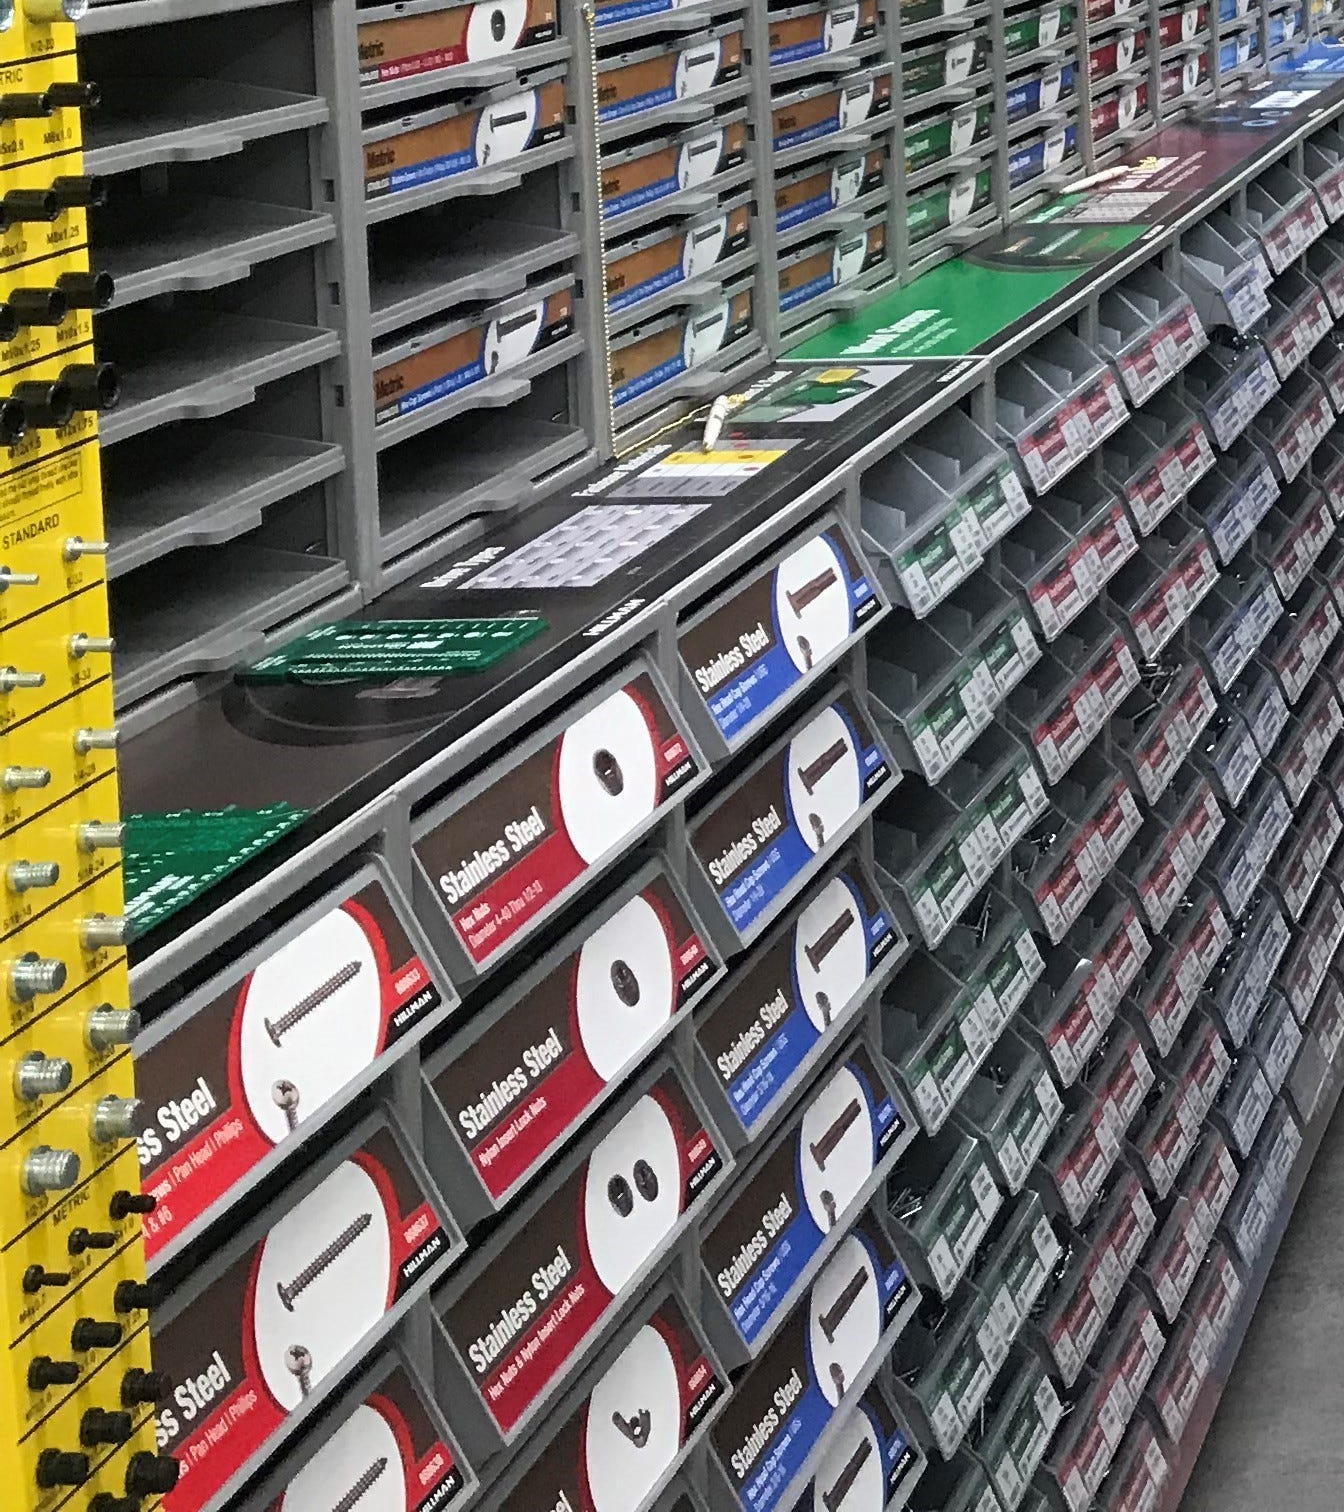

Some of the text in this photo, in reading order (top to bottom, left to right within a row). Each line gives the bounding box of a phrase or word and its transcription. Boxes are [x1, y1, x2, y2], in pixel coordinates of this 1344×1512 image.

[366, 147, 395, 171] Metric
[840, 309, 940, 354] Wood Screws
[375, 374, 403, 400] Metric
[3, 514, 59, 550] STANDARD
[420, 567, 472, 587] Drive
[583, 598, 646, 637] HILLMAN
[695, 622, 769, 692] Stainless Steel
[440, 806, 546, 904] Stainless Steel
[709, 804, 782, 885] Stainless Steel
[460, 913, 476, 932] Hex
[393, 991, 432, 1026] HILLMAN
[716, 988, 788, 1080] Stainless Steel
[459, 1027, 563, 1139] Stainless Steel
[157, 1077, 217, 1142] Steel
[478, 1097, 547, 1167] Nylon Insert Lock Nuts
[172, 1161, 192, 1182] Pan
[188, 1141, 213, 1168] Head
[213, 1119, 243, 1147] Phillips
[689, 1158, 715, 1188] HILLMAN
[53, 1191, 89, 1225] METRIC
[157, 1205, 172, 1226] #6
[403, 1237, 441, 1277] HILLMAN
[718, 1192, 792, 1297] Stainless Steel
[468, 1245, 572, 1373] Stainless Steel
[500, 1365, 517, 1386] Nuts
[520, 1340, 541, 1361] Nylon
[538, 1321, 557, 1344] Insert
[554, 1304, 572, 1326] Lock
[567, 1283, 585, 1309] Nuts
[174, 1351, 231, 1420] Steel
[689, 1384, 716, 1417] HILLMAN
[189, 1439, 209, 1462] Pan
[204, 1418, 229, 1445] Head
[731, 1368, 802, 1478] Stainless Steel
